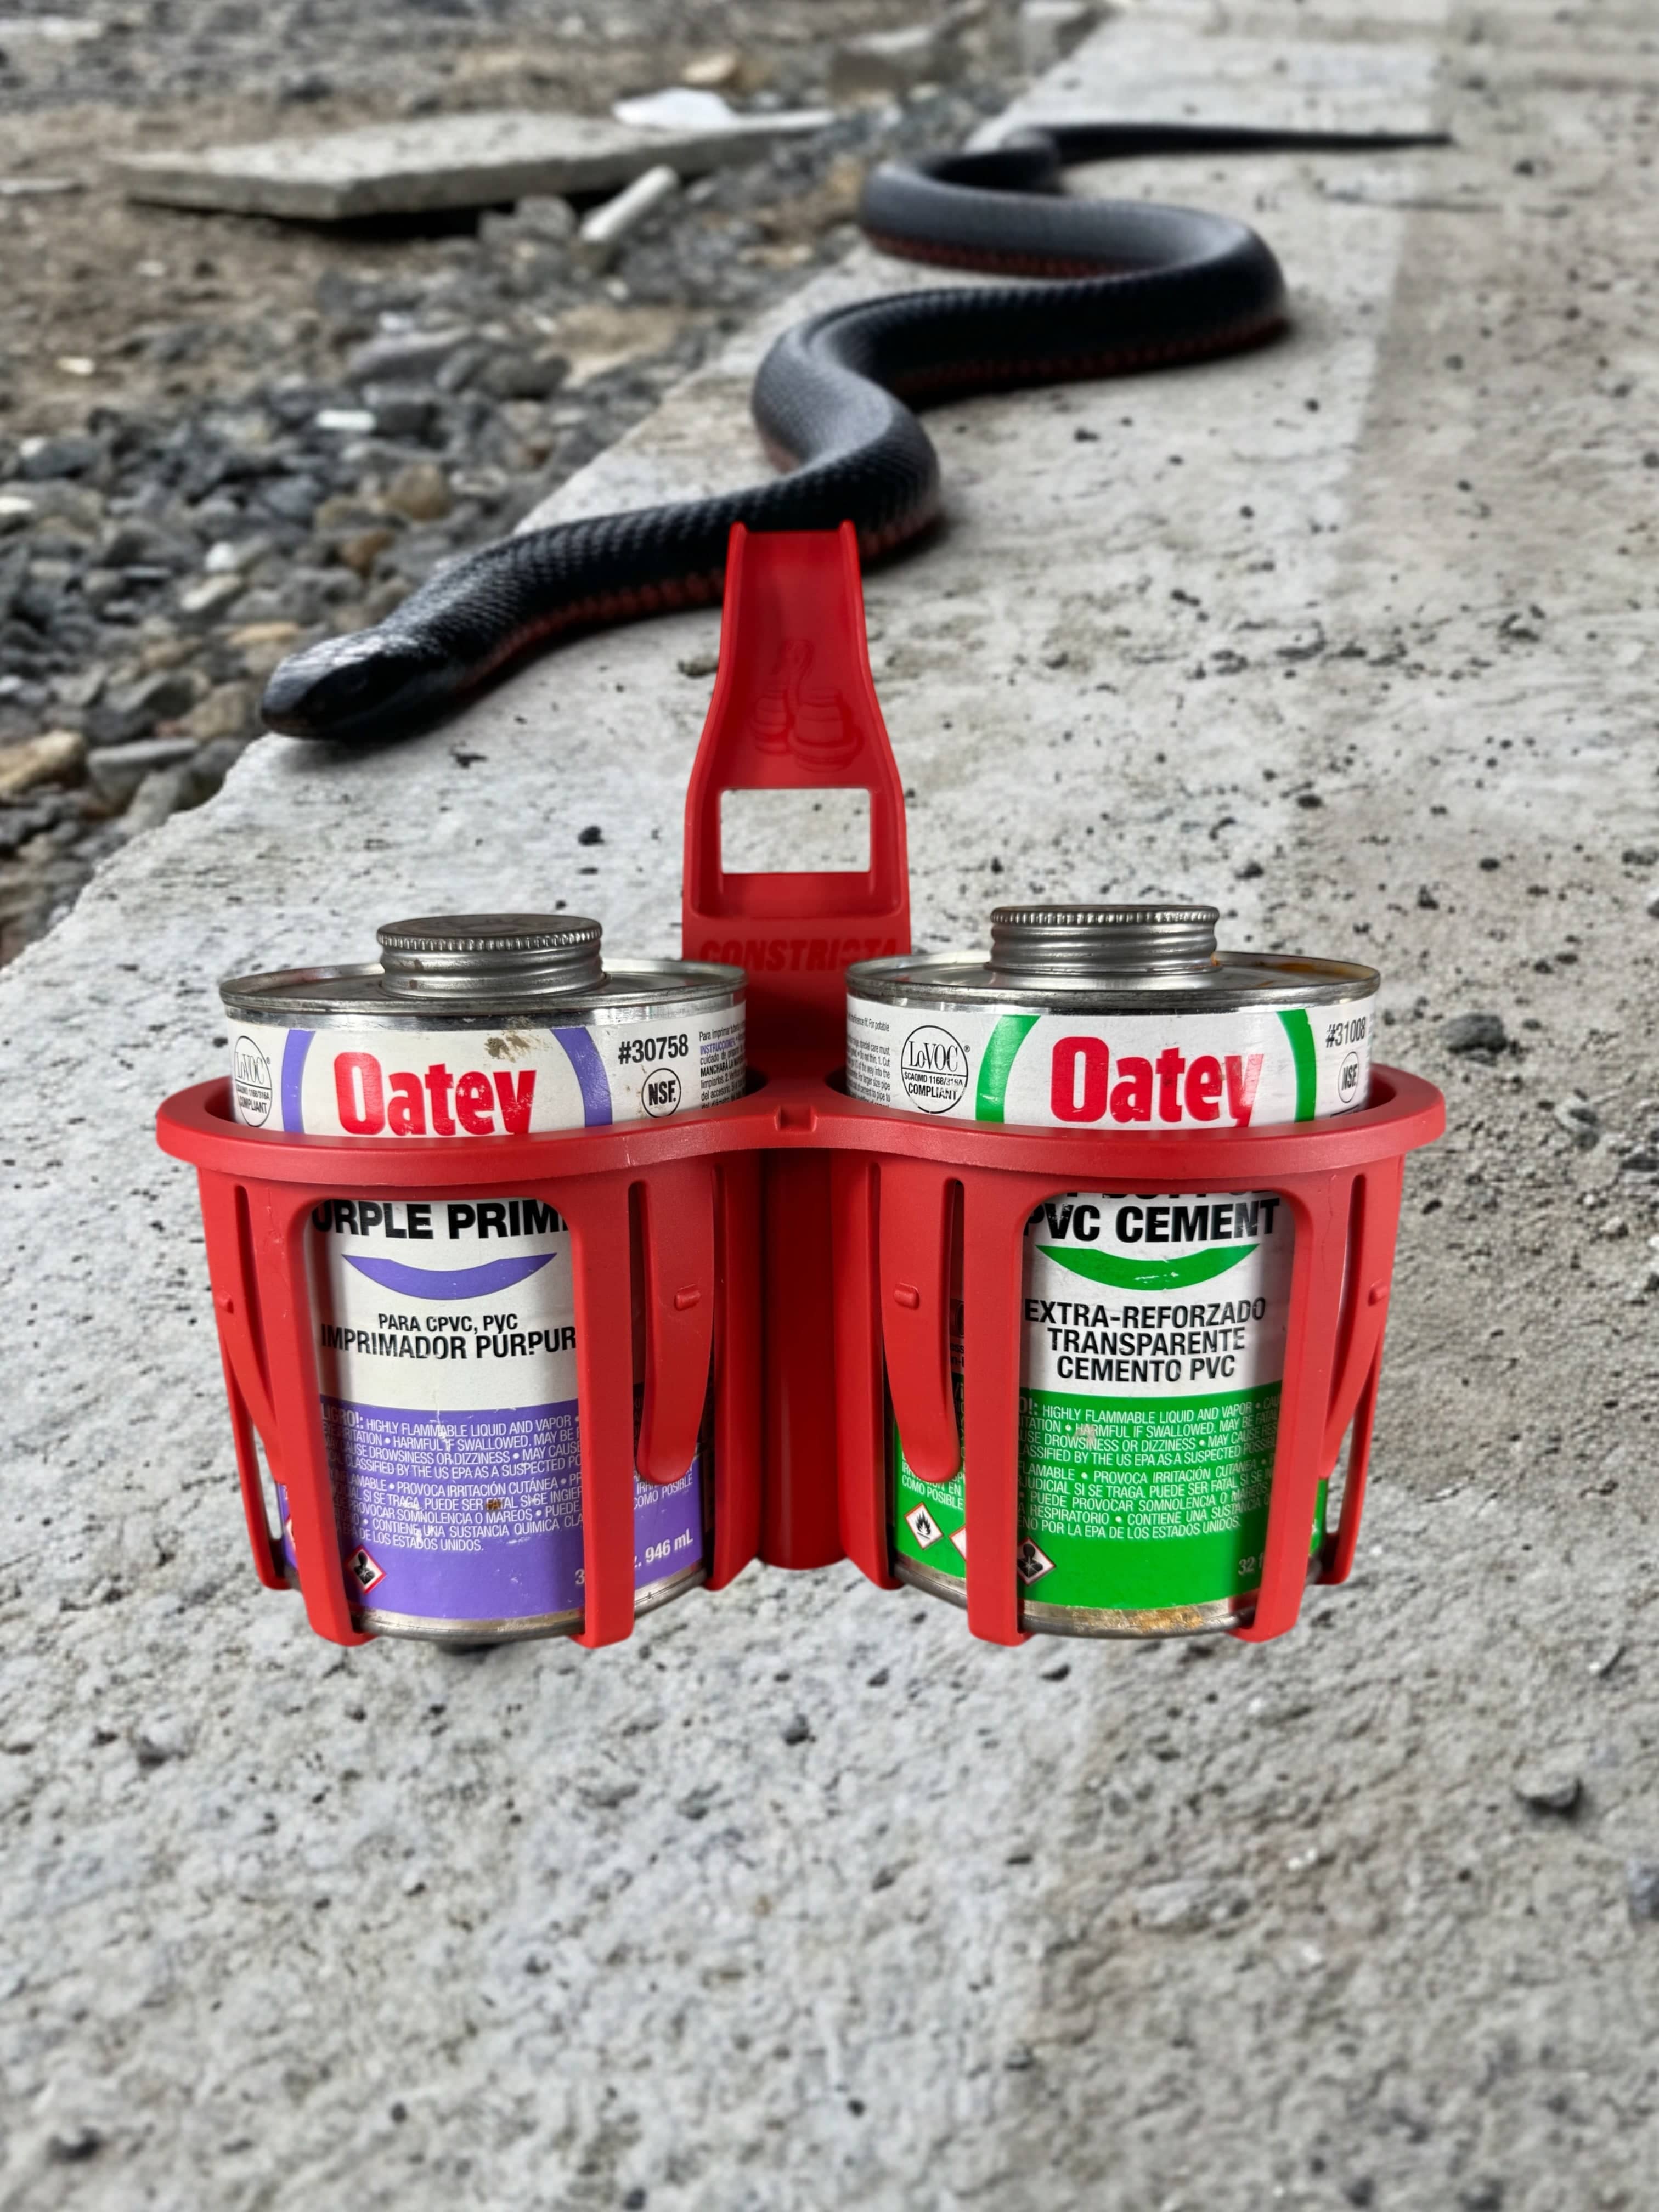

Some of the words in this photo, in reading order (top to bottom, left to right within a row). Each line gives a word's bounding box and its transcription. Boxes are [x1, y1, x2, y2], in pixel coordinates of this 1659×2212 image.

[699, 1031, 710, 1042] Para
[1325, 1016, 1366, 1048] #31008
[618, 1034, 689, 1064] #30758
[879, 1045, 890, 1056] must
[881, 1080, 890, 1091] pipe
[905, 1072, 927, 1082] SCAQMD
[1050, 1037, 1265, 1128] Oatey
[334, 1052, 537, 1136] Oatey
[909, 1082, 957, 1100] COMPLIANT
[312, 1199, 433, 1239] URPLE
[447, 1199, 569, 1239] PRIM
[1115, 1198, 1280, 1243] CEMENT
[379, 1313, 421, 1332] PARA
[427, 1314, 478, 1334] CPVC,
[483, 1313, 518, 1331] PVC
[1025, 1296, 1266, 1329] EXTRA-REFORZADO
[321, 1323, 467, 1359] IMPRIMADOR
[1047, 1327, 1245, 1356] TRANSPARENTE
[1057, 1355, 1182, 1382] CEMENTO
[1190, 1355, 1235, 1381] PVC
[1042, 1404, 1081, 1420] HIGHLY
[1085, 1409, 1155, 1424] FLAMMABLE
[1160, 1410, 1194, 1424] LIQUID
[1197, 1407, 1218, 1421] AND
[1222, 1402, 1252, 1417] VAPOR
[366, 1419, 399, 1434] HIGHLY
[402, 1422, 467, 1437] FLAMMABLE
[471, 1423, 506, 1436] LIQUID
[509, 1420, 533, 1435] AND
[535, 1415, 571, 1431] VAPOR
[1020, 1415, 1060, 1433] ITATION
[1075, 1423, 1130, 1438] HARMFUL
[1133, 1426, 1143, 1437] IF
[1146, 1422, 1216, 1438] SWALLOWED.
[1220, 1418, 1240, 1432] MAY
[1242, 1415, 1254, 1428] BE
[393, 1436, 443, 1451] HARMFUL
[457, 1435, 532, 1451] SWALLOWED.
[534, 1431, 557, 1446] MAY
[560, 1428, 574, 1442] BE
[1044, 1433, 1119, 1452] DROWSINESS
[1122, 1440, 1138, 1452] OR
[1141, 1437, 1196, 1452] DIZZINESS
[1207, 1434, 1229, 1447] MAY
[1231, 1427, 1260, 1444] CAUSE
[369, 1446, 434, 1465] DROWSINESS
[437, 1453, 451, 1465] OR
[454, 1451, 510, 1465] DIZZINESS
[522, 1447, 545, 1461] MAY
[549, 1441, 581, 1459] CAUSE
[1023, 1443, 1070, 1462] ASSIFIED
[1074, 1451, 1088, 1464] BY
[1091, 1452, 1113, 1465] THE
[1116, 1453, 1131, 1466] US
[1135, 1454, 1155, 1466] EPA
[1157, 1453, 1172, 1466] AS
[1174, 1453, 1182, 1465] A
[1184, 1444, 1241, 1464] SUSPECTED
[397, 1464, 409, 1476] BY
[411, 1465, 431, 1478] THE
[435, 1467, 449, 1479] US
[452, 1467, 474, 1479] EPA
[474, 1465, 489, 1478] AS
[492, 1467, 500, 1477] A
[502, 1458, 565, 1476] SUSPECTED
[1093, 1470, 1148, 1485] PROVOCA
[1153, 1466, 1211, 1483] IRRITACIÓN
[1215, 1460, 1257, 1478] CUTÁNEA
[397, 1481, 445, 1496] PROVOCA
[447, 1481, 506, 1497] IRRITACIÓN
[509, 1477, 558, 1494] CUTÁNEA
[662, 1473, 693, 1498] POSIBLE
[902, 1474, 925, 1495] COMO
[927, 1486, 964, 1510] POSIBLE
[949, 1482, 961, 1497] EN
[1074, 1482, 1085, 1496] SI
[1088, 1484, 1103, 1497] SE
[1106, 1485, 1146, 1499] TRAGA.
[1149, 1483, 1185, 1498] PUEDE
[1188, 1481, 1207, 1495] SER
[1211, 1477, 1238, 1492] FATAL
[1240, 1474, 1249, 1486] SI
[1251, 1470, 1262, 1483] SE
[364, 1489, 371, 1502] SI
[374, 1491, 386, 1504] SE
[425, 1498, 459, 1510] PUEDE
[462, 1498, 483, 1510] SER
[486, 1496, 518, 1510] FATAL
[521, 1494, 531, 1507] SI
[534, 1492, 547, 1505] SE
[551, 1486, 582, 1502] INGIER
[1030, 1491, 1066, 1508] PUEDE
[1072, 1497, 1133, 1512] PROVOCAR
[1138, 1494, 1216, 1511] SOMNOLENCIA
[1220, 1492, 1227, 1504] O
[1231, 1482, 1268, 1502] MAREOS
[350, 1500, 396, 1519] PROVOCAR
[397, 1509, 473, 1525] SOMNOLENCIA
[475, 1513, 483, 1524] O
[486, 1509, 533, 1523] MAREOS
[545, 1500, 579, 1517] PUEDE
[1030, 1504, 1109, 1525] RESPIRATORIO
[1127, 1512, 1181, 1526] CONTIENE
[1186, 1509, 1207, 1522] UNA
[1211, 1497, 1261, 1519] SUSTANCIA
[360, 1528, 371, 1541] DE
[373, 1531, 391, 1544] LOS
[393, 1534, 438, 1550] ESTADOS
[441, 1539, 484, 1551] UNIDOS.
[373, 1517, 418, 1536] CONTIENE
[424, 1525, 445, 1537] UNA
[449, 1525, 510, 1538] SUSTANCIA
[1042, 1520, 1064, 1534] POR
[1068, 1524, 1082, 1537] LA
[1085, 1525, 1106, 1538] EPA
[1109, 1527, 1124, 1538] DE
[1127, 1527, 1149, 1539] LOS
[1152, 1522, 1200, 1538] ESTADOS
[1203, 1516, 1240, 1534] UNIDOS.
[575, 1568, 585, 1585] 3
[645, 1539, 670, 1564] 946
[674, 1528, 693, 1551] mL
[1238, 1556, 1256, 1576] 32
